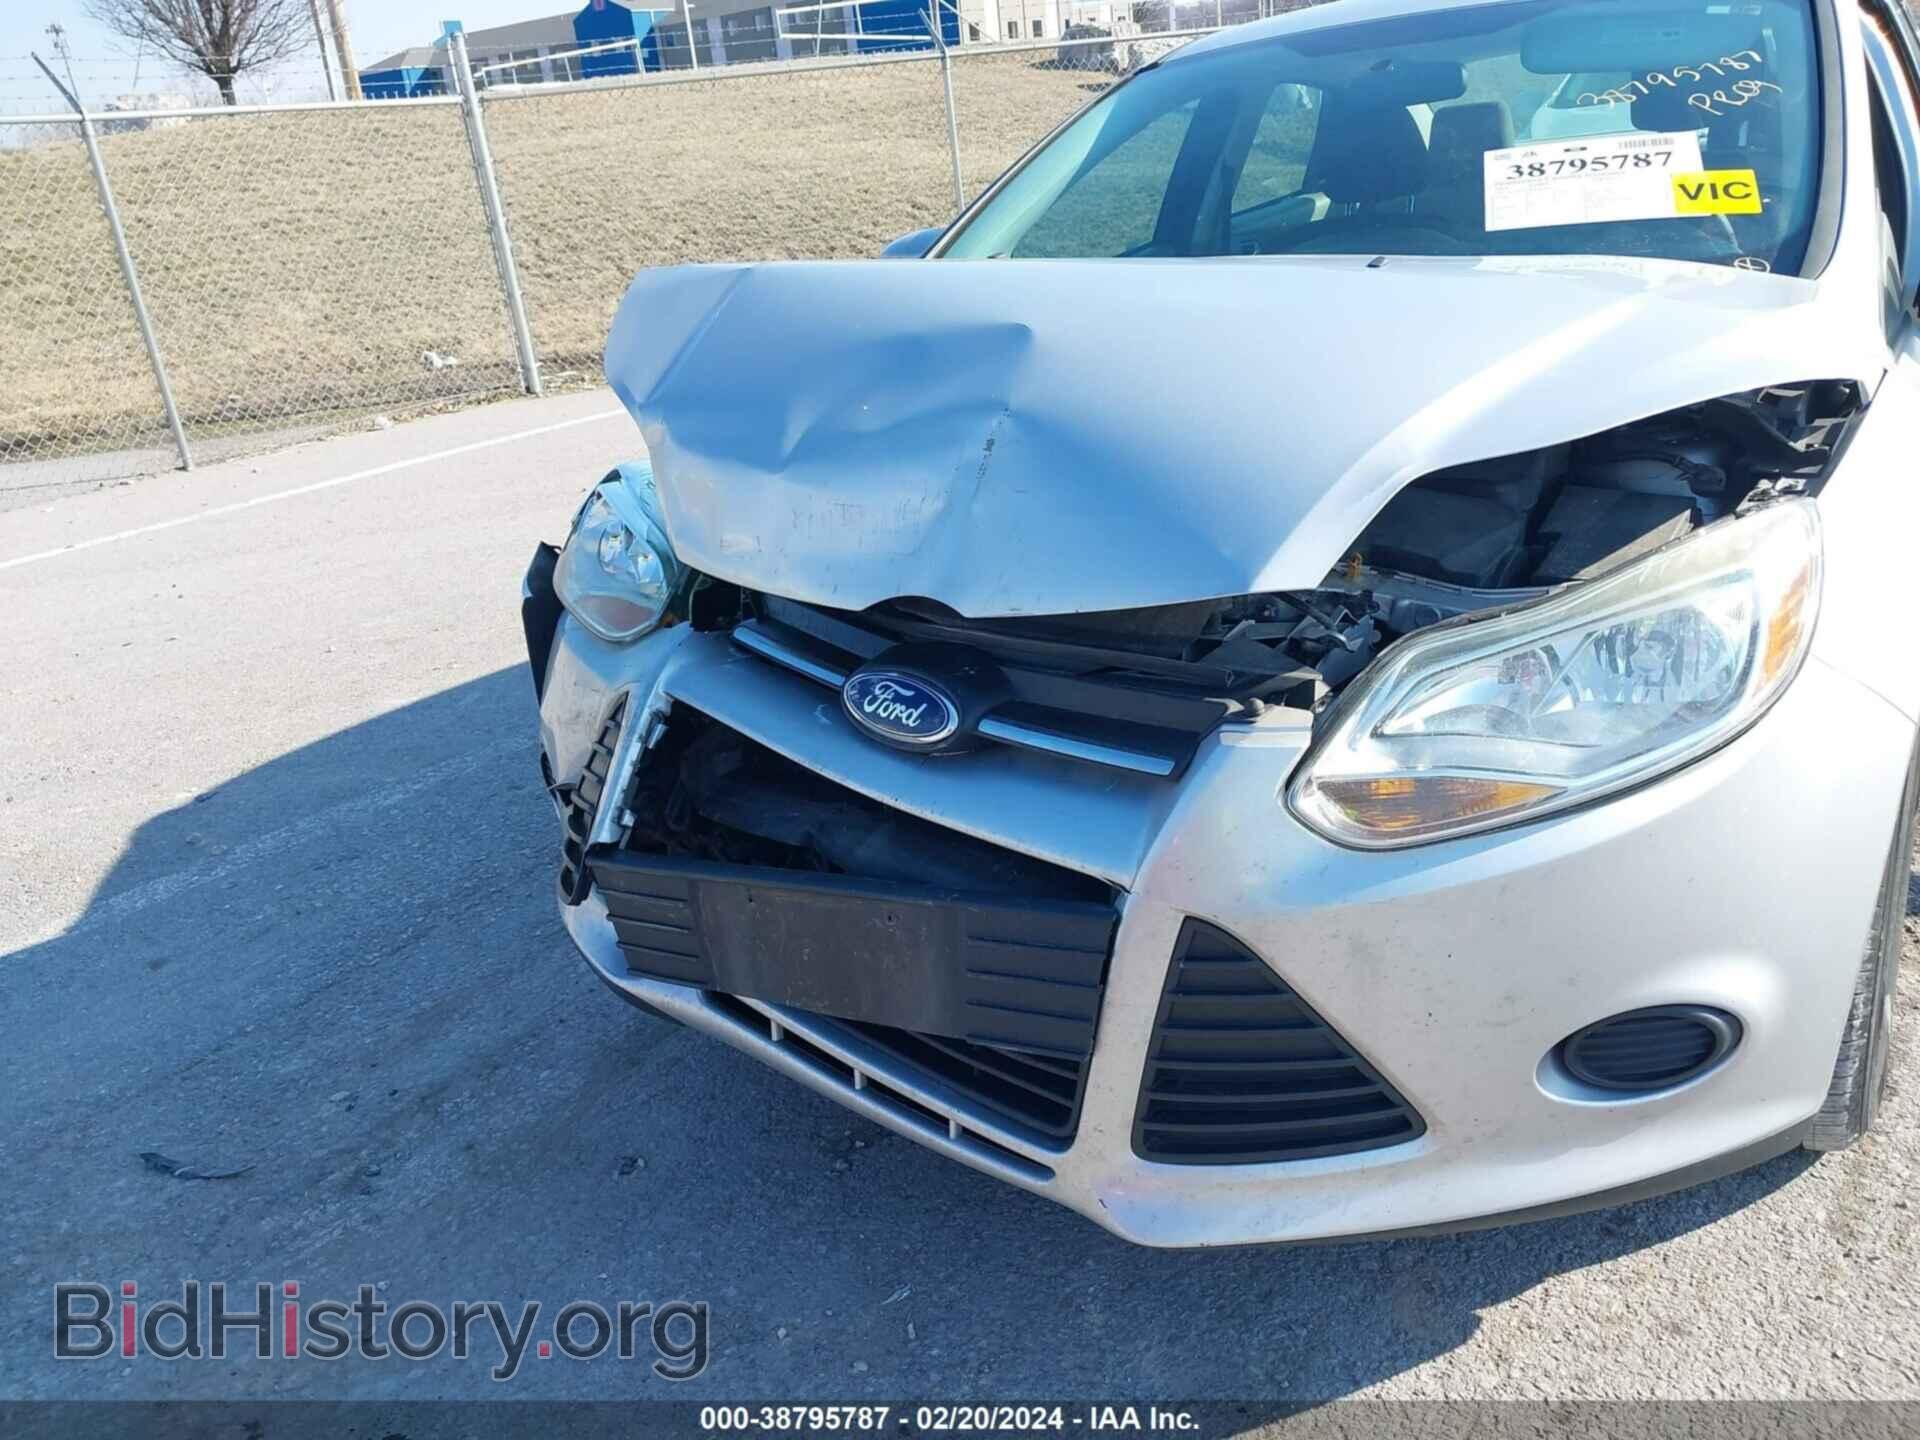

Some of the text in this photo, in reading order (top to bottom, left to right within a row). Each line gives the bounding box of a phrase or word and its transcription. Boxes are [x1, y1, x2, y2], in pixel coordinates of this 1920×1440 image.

[1576, 50, 1762, 110] 38795787
[1506, 151, 1673, 180] 38795787
[1677, 181, 1752, 201] VIC
[863, 681, 927, 727] Ford
